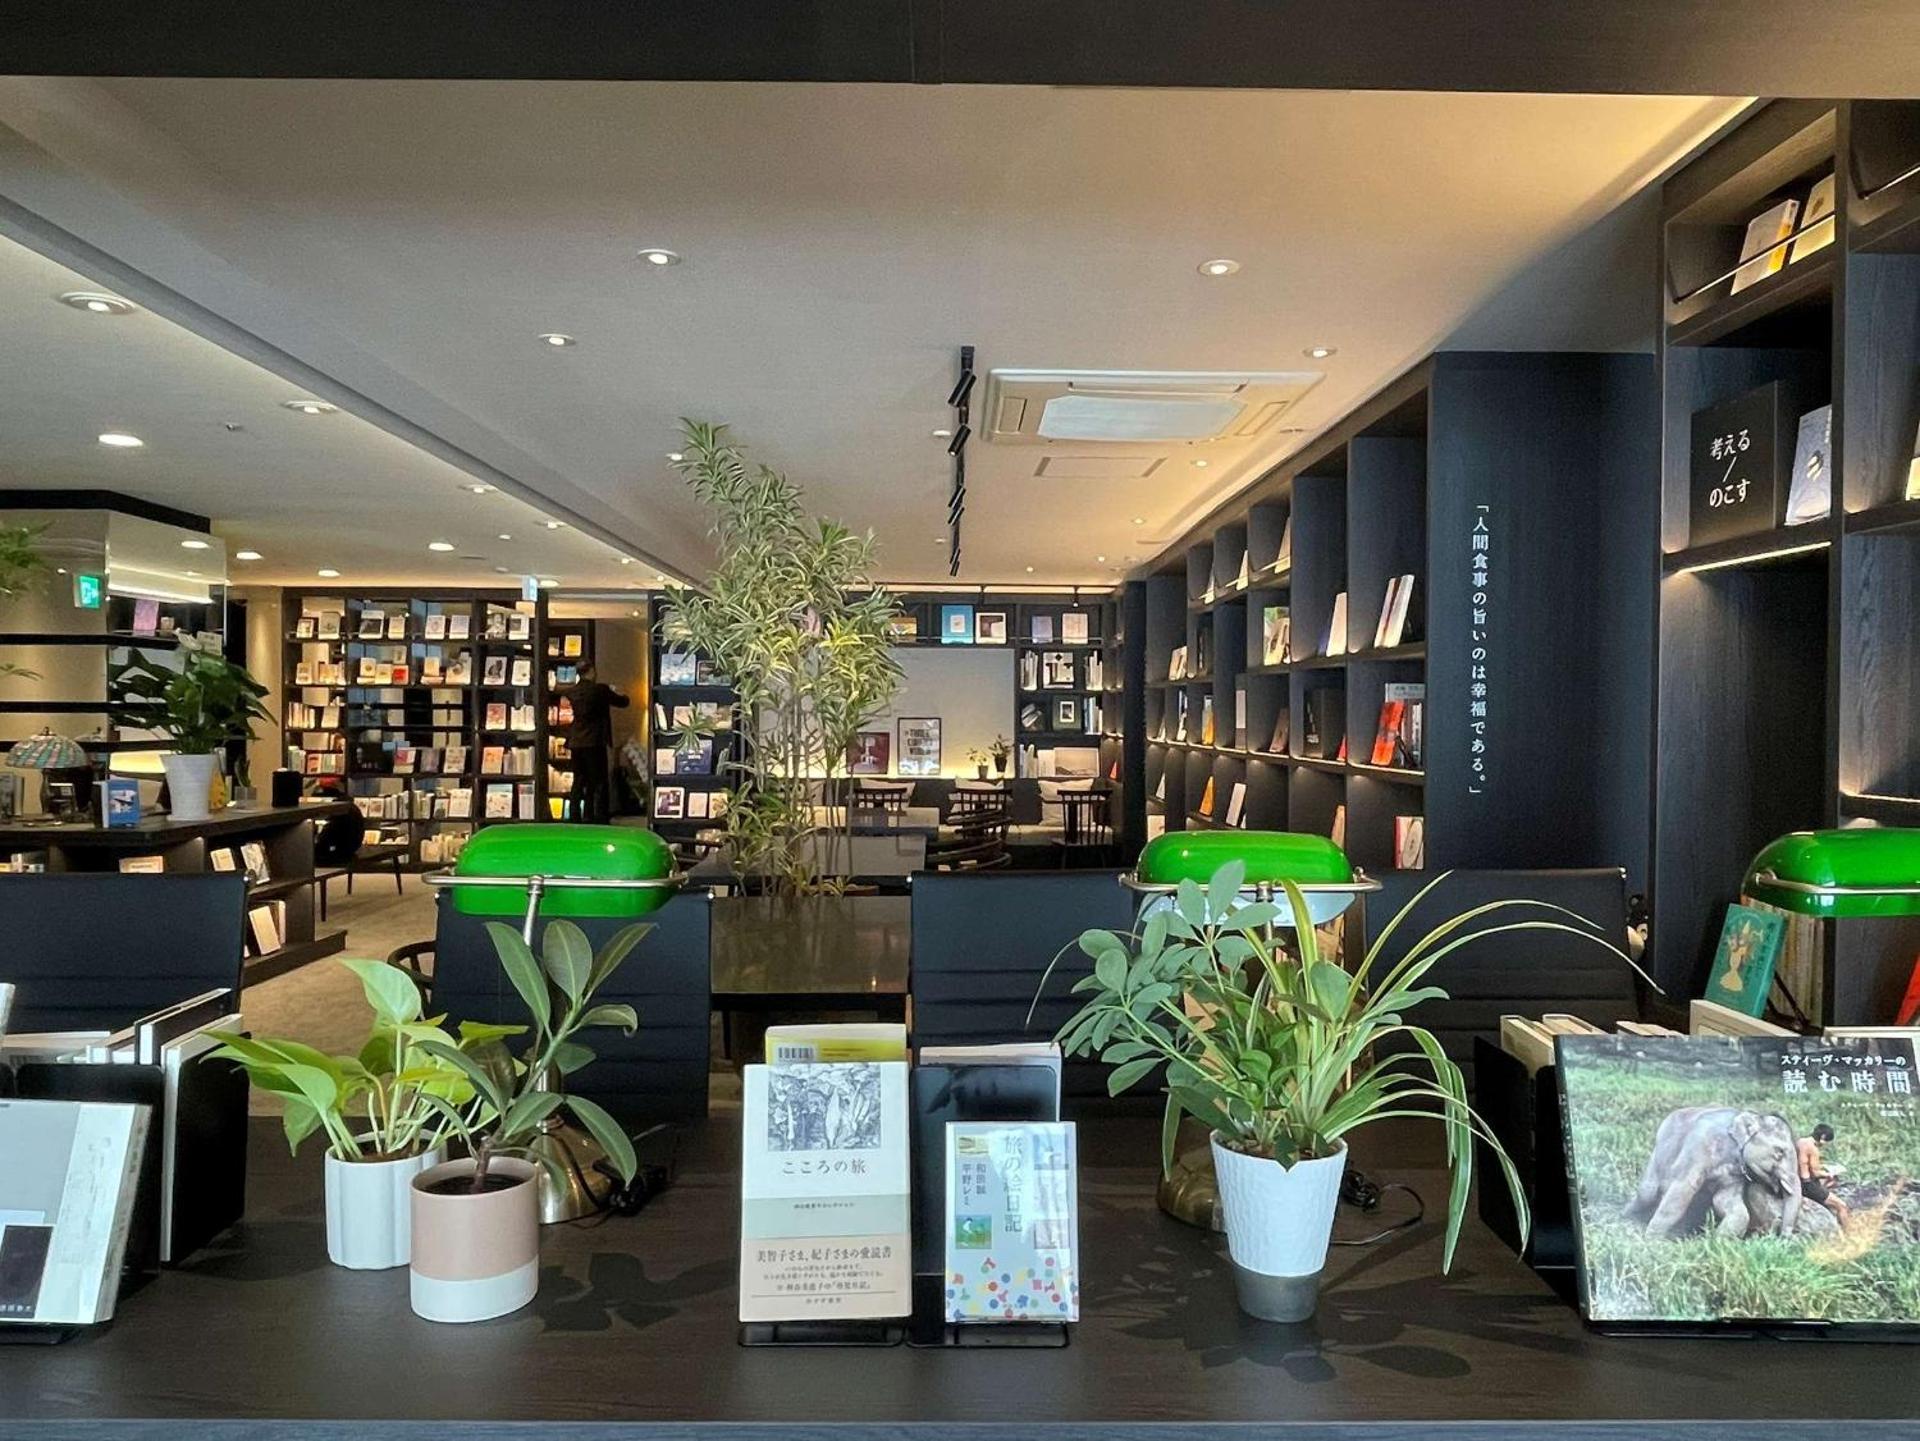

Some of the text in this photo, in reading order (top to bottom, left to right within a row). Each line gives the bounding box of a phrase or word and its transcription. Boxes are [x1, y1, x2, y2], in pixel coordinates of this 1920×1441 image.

[1709, 429, 1751, 460] 考える
[1709, 478, 1751, 508] のこす
[1468, 503, 1490, 795] 「人間食事の旨いのは幸福である。」
[1781, 1069, 1912, 1095] 読む時間
[782, 1158, 867, 1175] こころの旅
